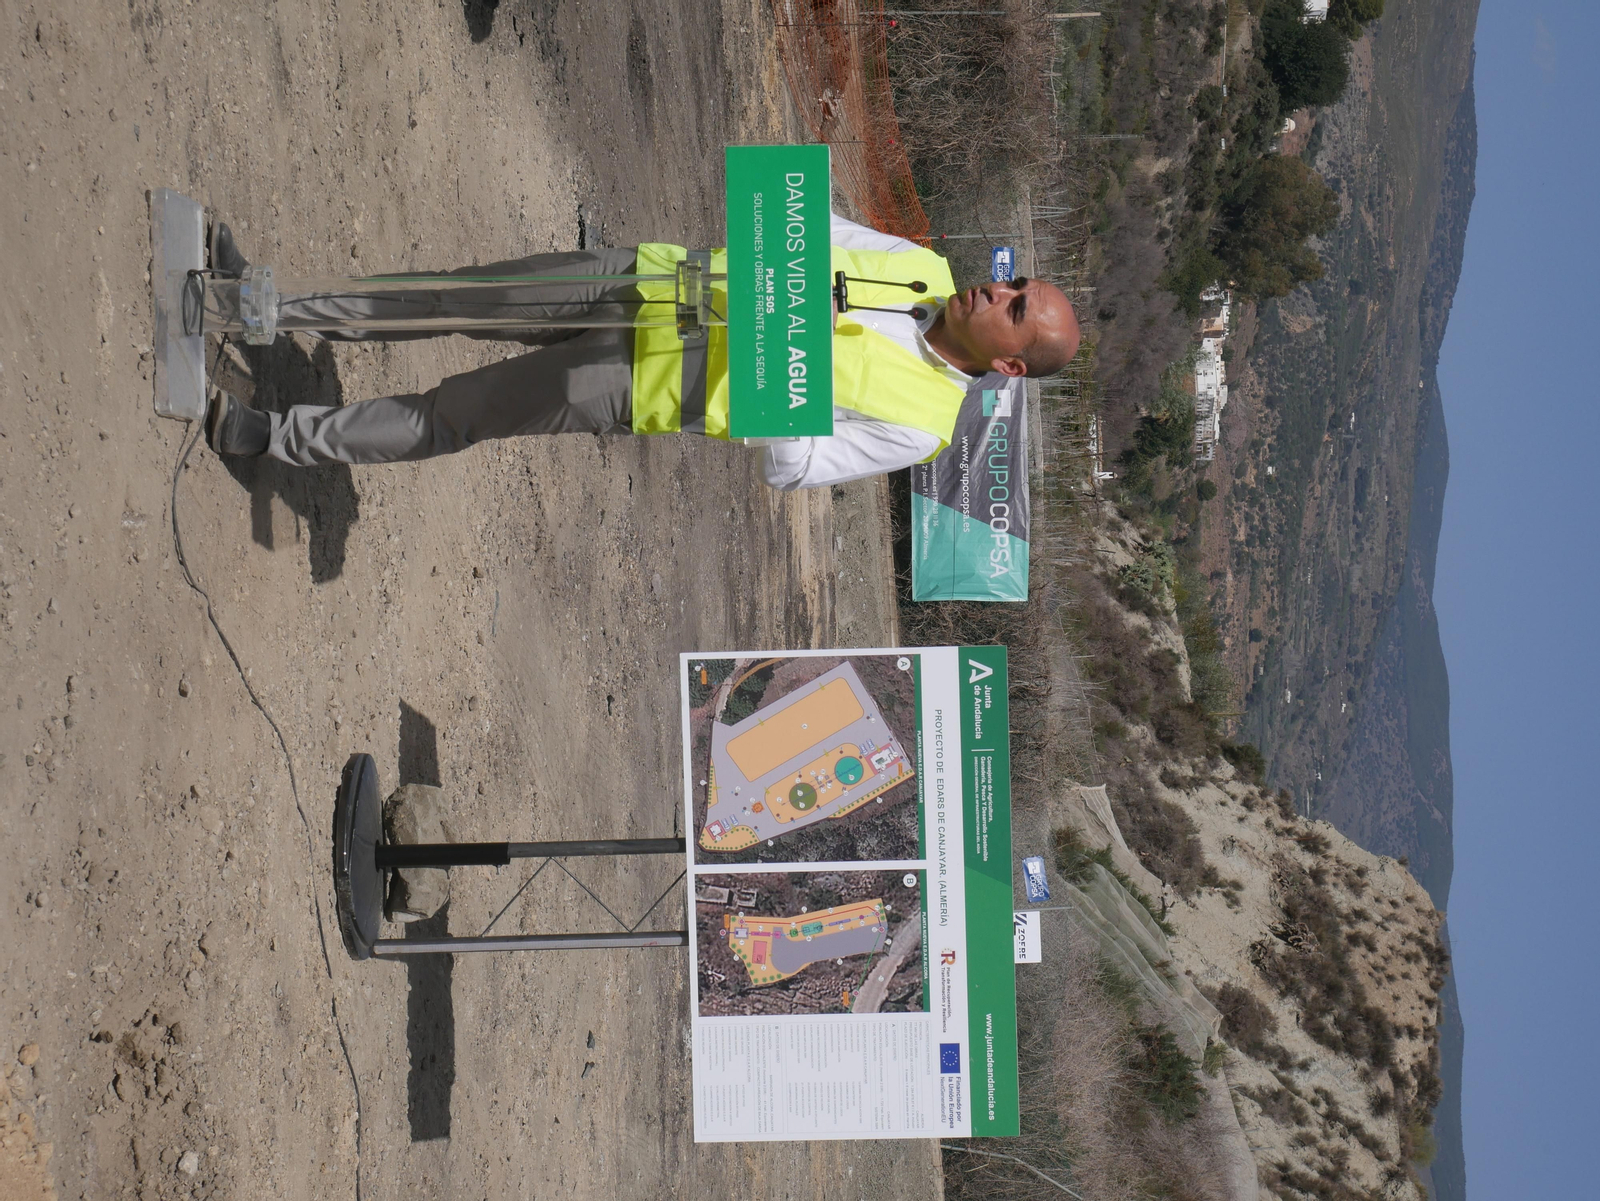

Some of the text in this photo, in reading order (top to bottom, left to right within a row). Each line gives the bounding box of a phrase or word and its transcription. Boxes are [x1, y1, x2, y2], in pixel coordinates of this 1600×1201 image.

[754, 192, 763, 251] SOLUCIONES
[755, 261, 764, 292] OBRAS
[766, 268, 774, 314] PLAN SOS
[786, 173, 807, 409] DAMOS VIDA AL AGUA
[755, 295, 764, 331] FRENTE
[756, 342, 764, 354] LA
[756, 356, 767, 389] SEQUÍA
[960, 436, 971, 532] www.grupocopsa.es
[988, 422, 1010, 578] GRUPOCOPSA
[974, 685, 983, 739] de Andalucía
[935, 709, 949, 926] PROYECTO DE EDARS DE CANJAYAR. (ALMERÍA)
